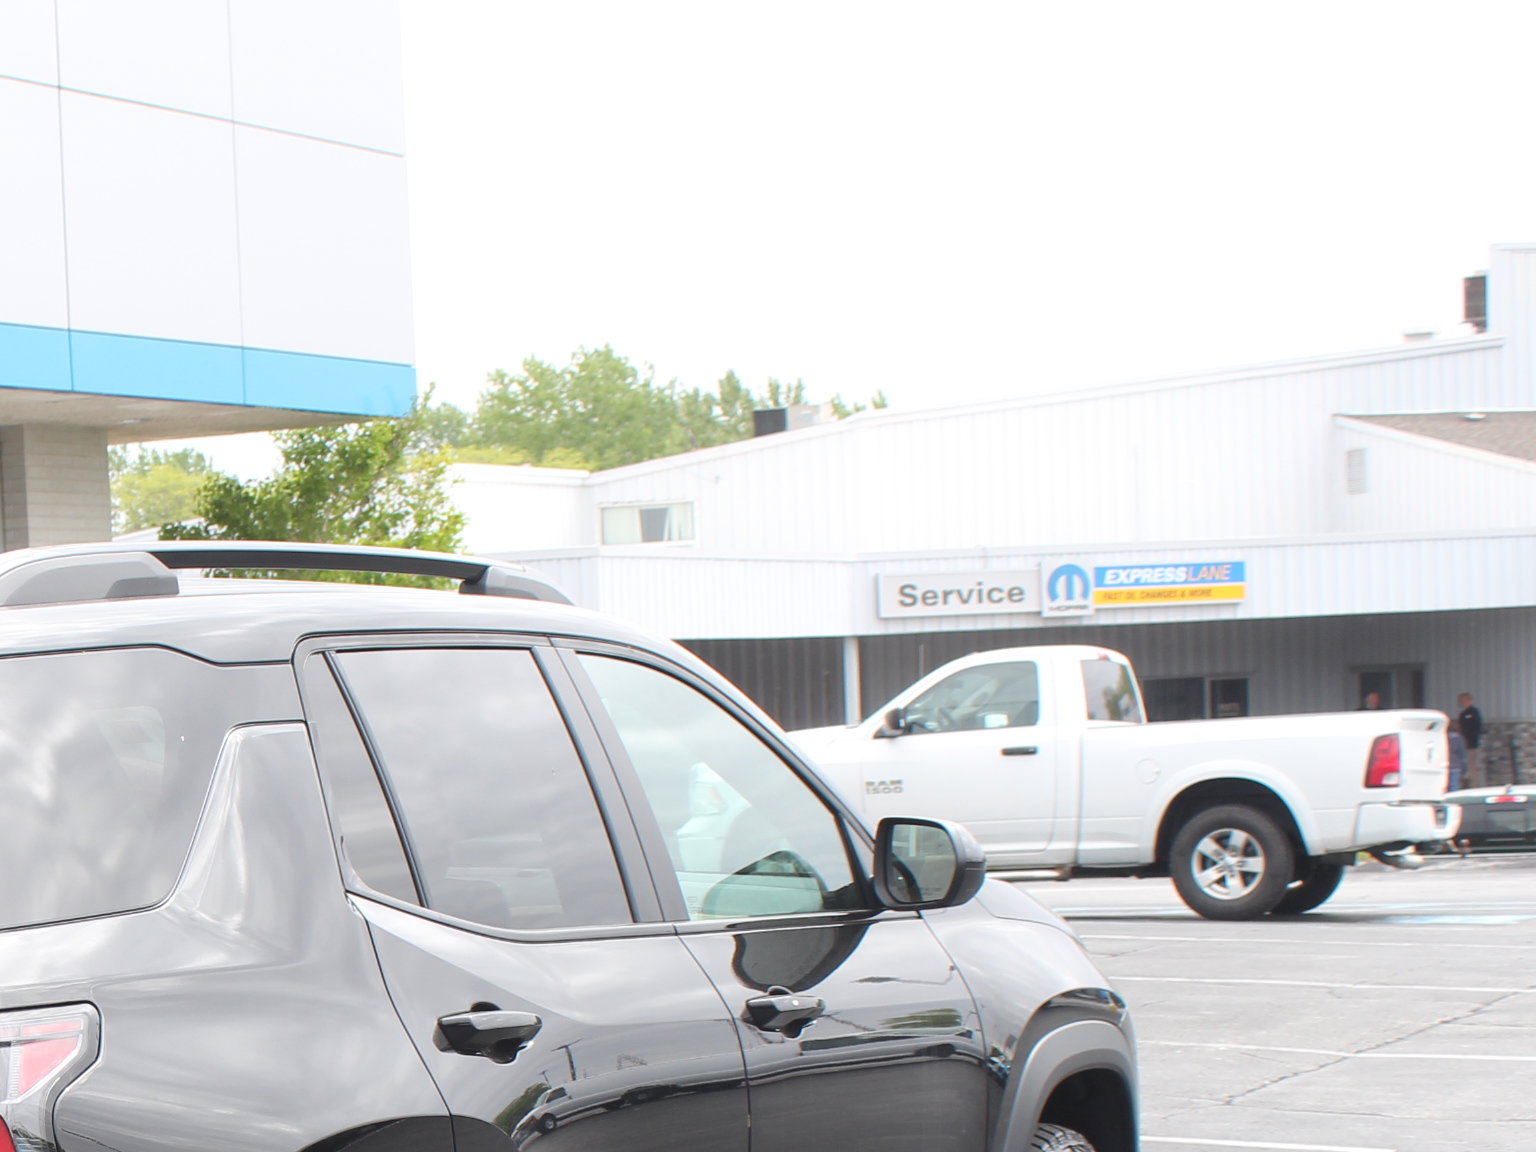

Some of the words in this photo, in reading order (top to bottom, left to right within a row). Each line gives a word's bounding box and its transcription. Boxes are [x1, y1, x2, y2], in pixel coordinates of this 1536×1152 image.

[898, 581, 1026, 607] Service
[865, 779, 904, 787] RAM
[865, 786, 904, 795] 1500
